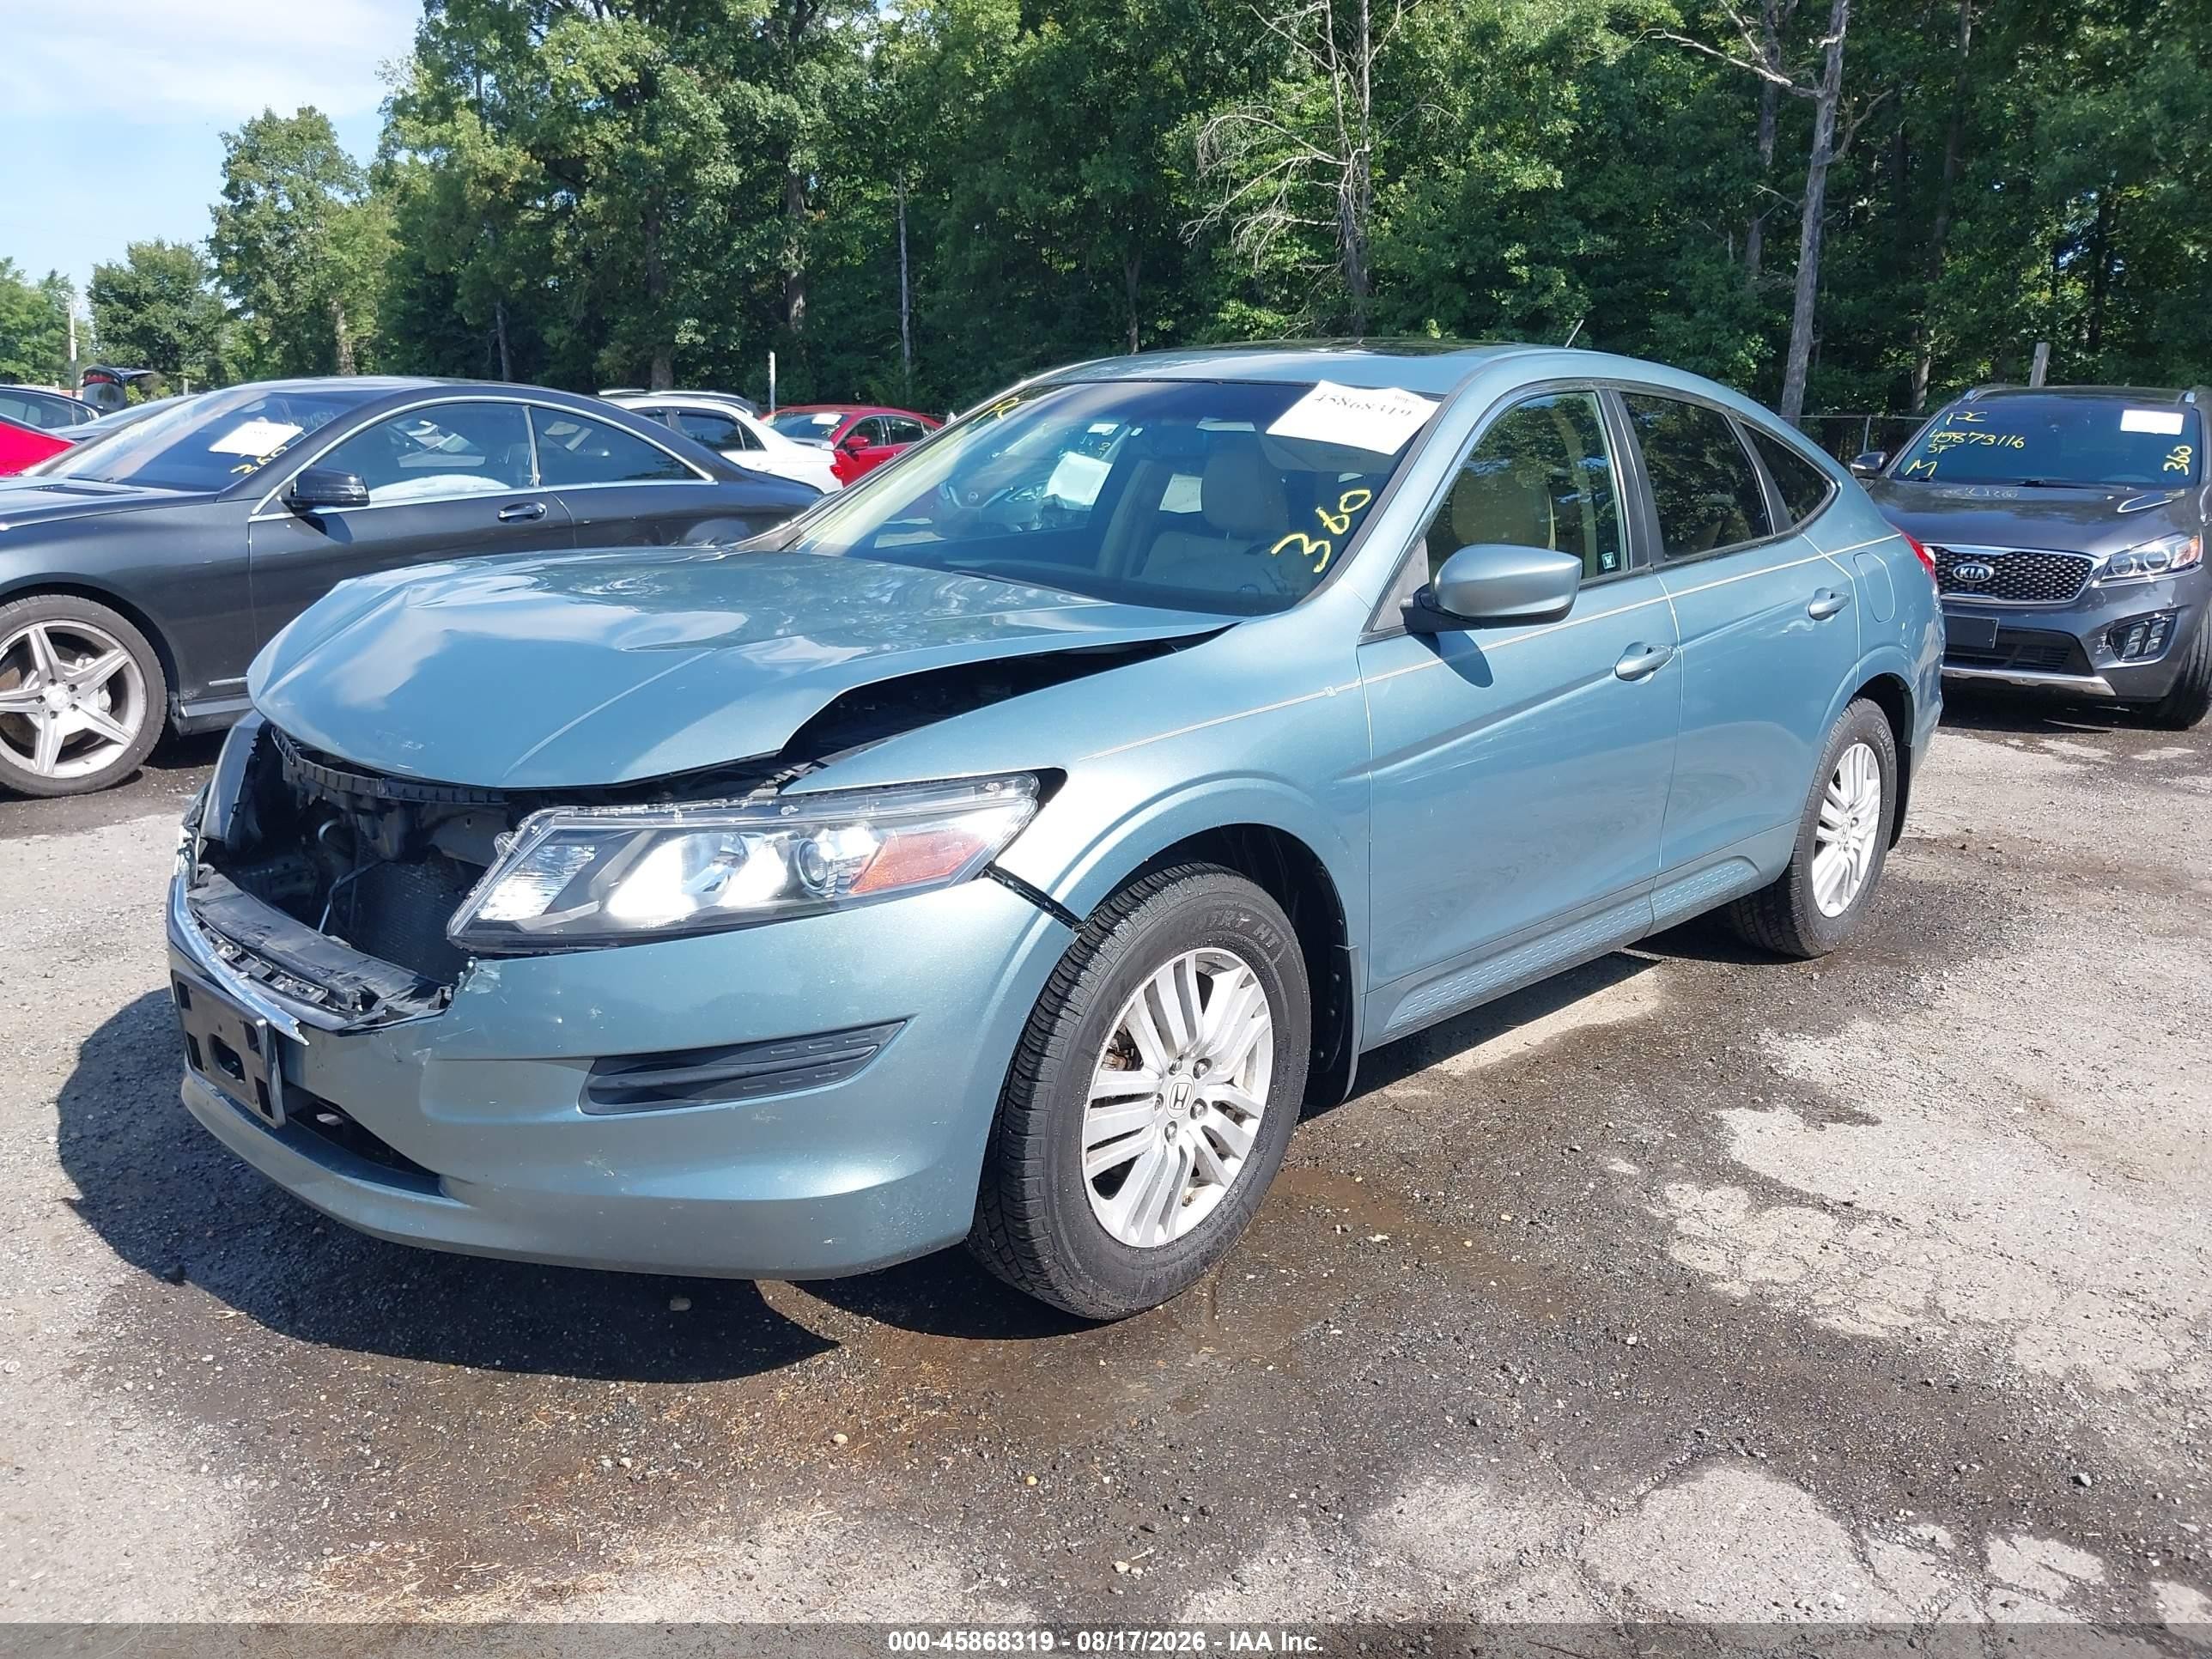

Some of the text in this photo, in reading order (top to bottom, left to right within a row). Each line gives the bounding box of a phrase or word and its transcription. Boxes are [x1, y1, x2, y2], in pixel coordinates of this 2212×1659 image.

[1929, 428, 2026, 449] 45873116
[1904, 459, 1938, 477] M
[2163, 445, 2193, 476] 360
[1270, 489, 1372, 574] 360
[1959, 567, 1985, 580] KIA
